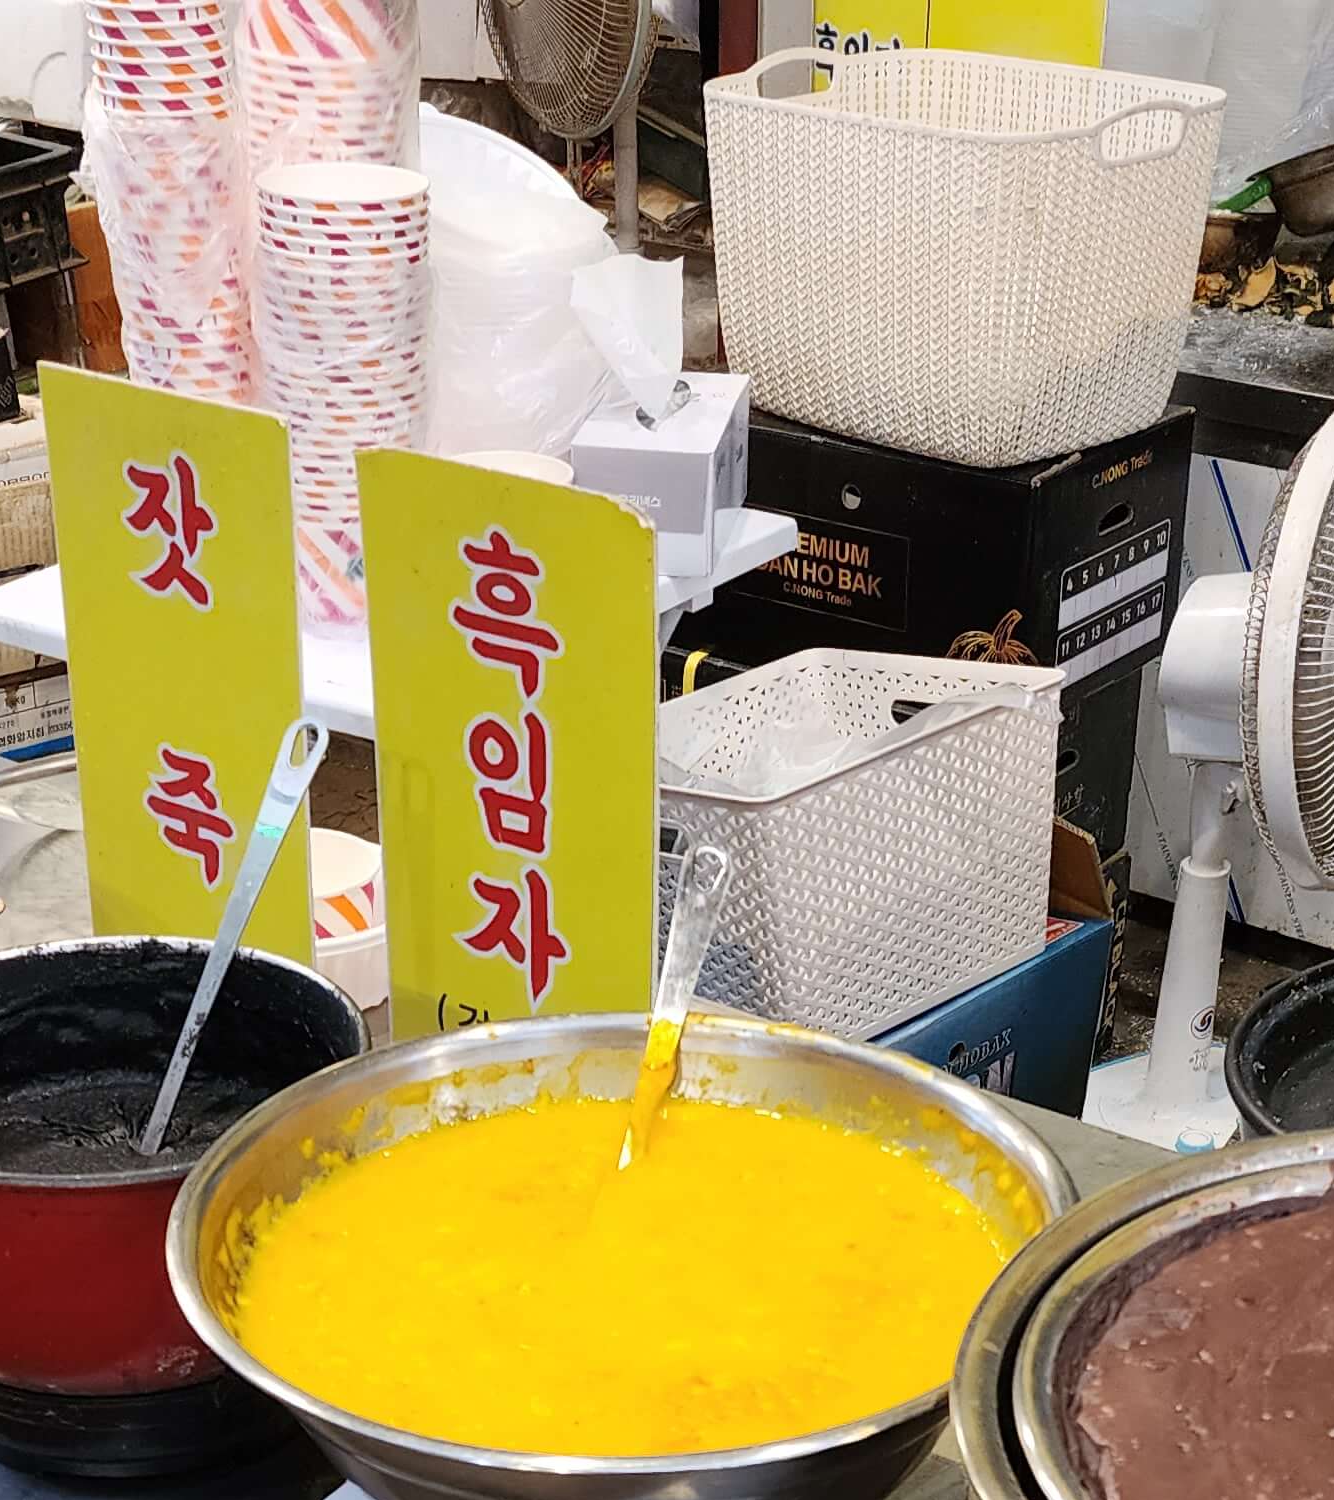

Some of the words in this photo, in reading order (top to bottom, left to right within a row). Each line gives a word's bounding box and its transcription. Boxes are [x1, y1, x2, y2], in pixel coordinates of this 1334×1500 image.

[1091, 460, 1129, 489] C.NONG
[123, 450, 217, 609] 잣
[1066, 576, 1074, 593] 4
[1082, 569, 1090, 585] 5
[1097, 561, 1105, 577] 6
[1113, 554, 1121, 569] 7
[1128, 546, 1136, 562] 8
[1143, 538, 1151, 554] 9
[1156, 530, 1167, 547] 10
[783, 581, 824, 600] C.NONG
[802, 559, 833, 586] HO
[838, 568, 884, 598] BAK
[1060, 641, 1070, 657] 11
[1075, 632, 1087, 649] 12
[1091, 624, 1102, 642] 13
[1106, 616, 1117, 634] 14
[1121, 608, 1132, 625] 15
[1136, 600, 1147, 617] 16
[1151, 592, 1162, 609] 17
[451, 528, 569, 1004] 흑임자
[147, 745, 234, 888] 죽
